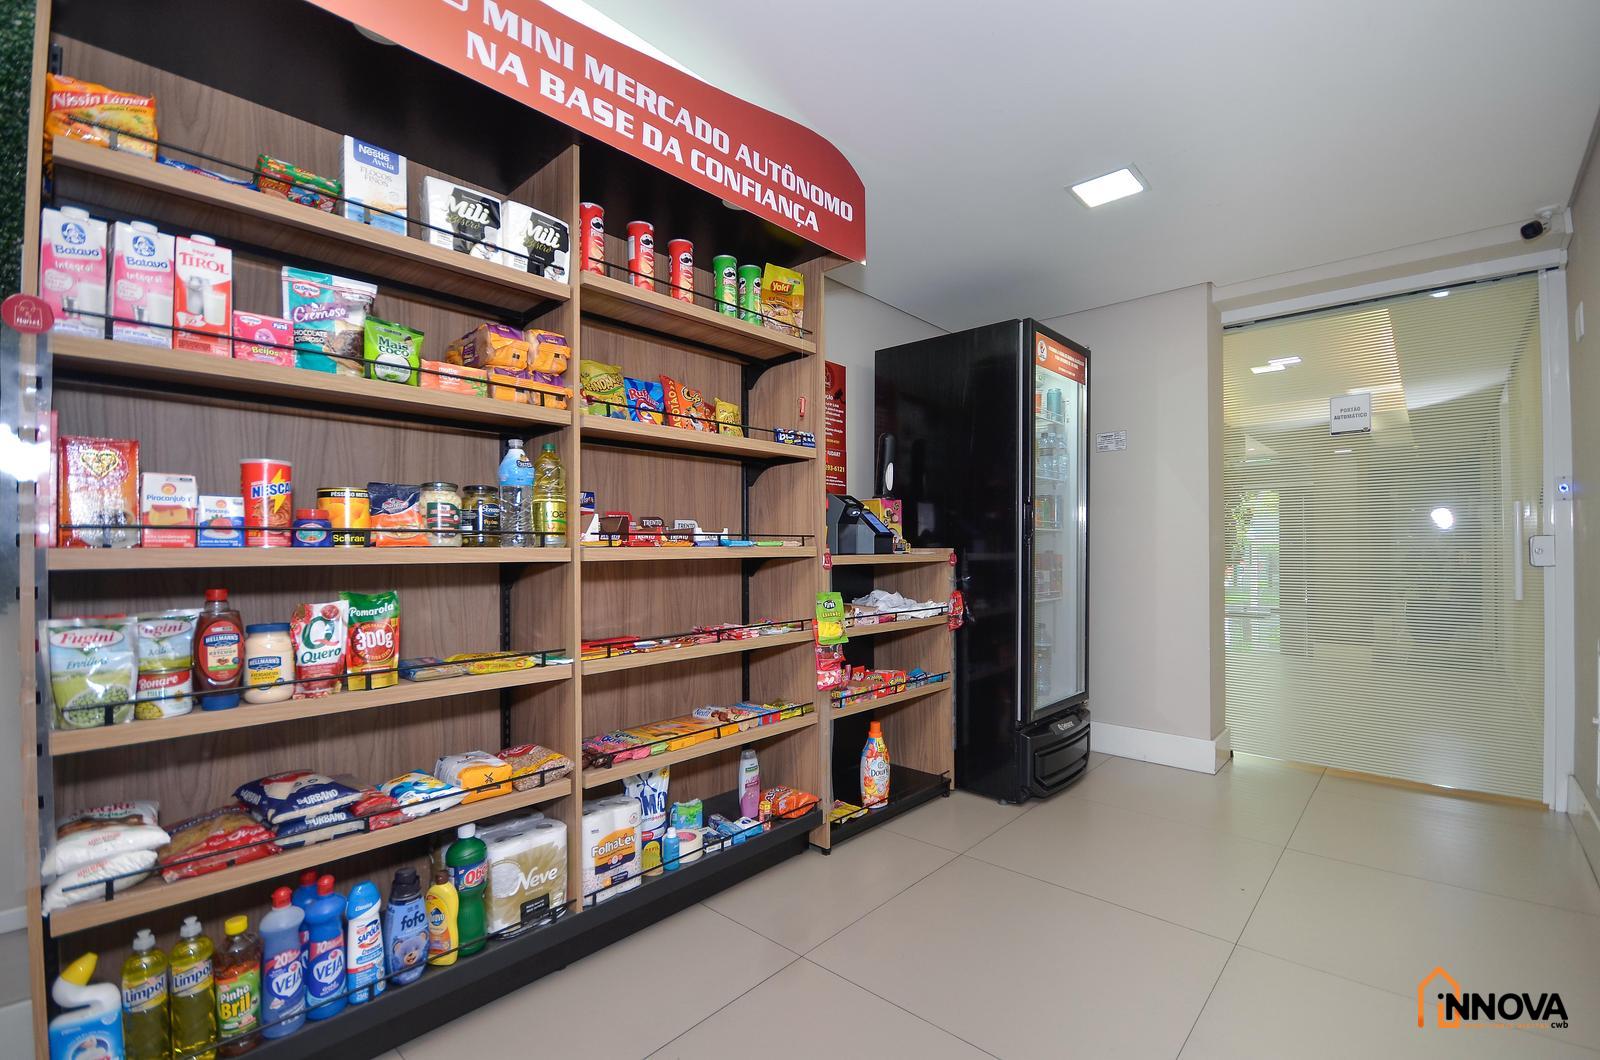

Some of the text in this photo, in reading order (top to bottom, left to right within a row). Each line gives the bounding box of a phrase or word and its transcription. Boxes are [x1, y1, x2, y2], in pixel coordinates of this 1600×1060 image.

[52, 92, 100, 109] Nissin
[483, 0, 853, 222] MINI MERCADO AUTÔNOMO
[466, 30, 819, 233] NA BASE DA CONFIANÇA
[448, 194, 490, 225] Mili
[527, 219, 561, 249] Mili
[55, 244, 100, 257] Batavo
[55, 260, 94, 272] Integral
[126, 256, 168, 269] Batavo
[179, 252, 229, 275] TIROL
[126, 271, 162, 284] Integral
[294, 306, 346, 323] Cremoso
[294, 329, 328, 338] HOCOLATE
[378, 335, 408, 351] Mais
[349, 602, 395, 617] Pomarola
[60, 631, 116, 647] Fugini
[355, 628, 393, 651] 300g
[301, 646, 342, 665] Quero
[519, 866, 558, 890] Neve
[401, 910, 425, 931] fofo
[173, 962, 212, 989] Limpol
[316, 955, 343, 981] VEJA
[124, 976, 164, 1003] Limpol
[275, 968, 301, 994] VEJA
[220, 984, 250, 1003] Pinho
[221, 992, 251, 1020] Bril
